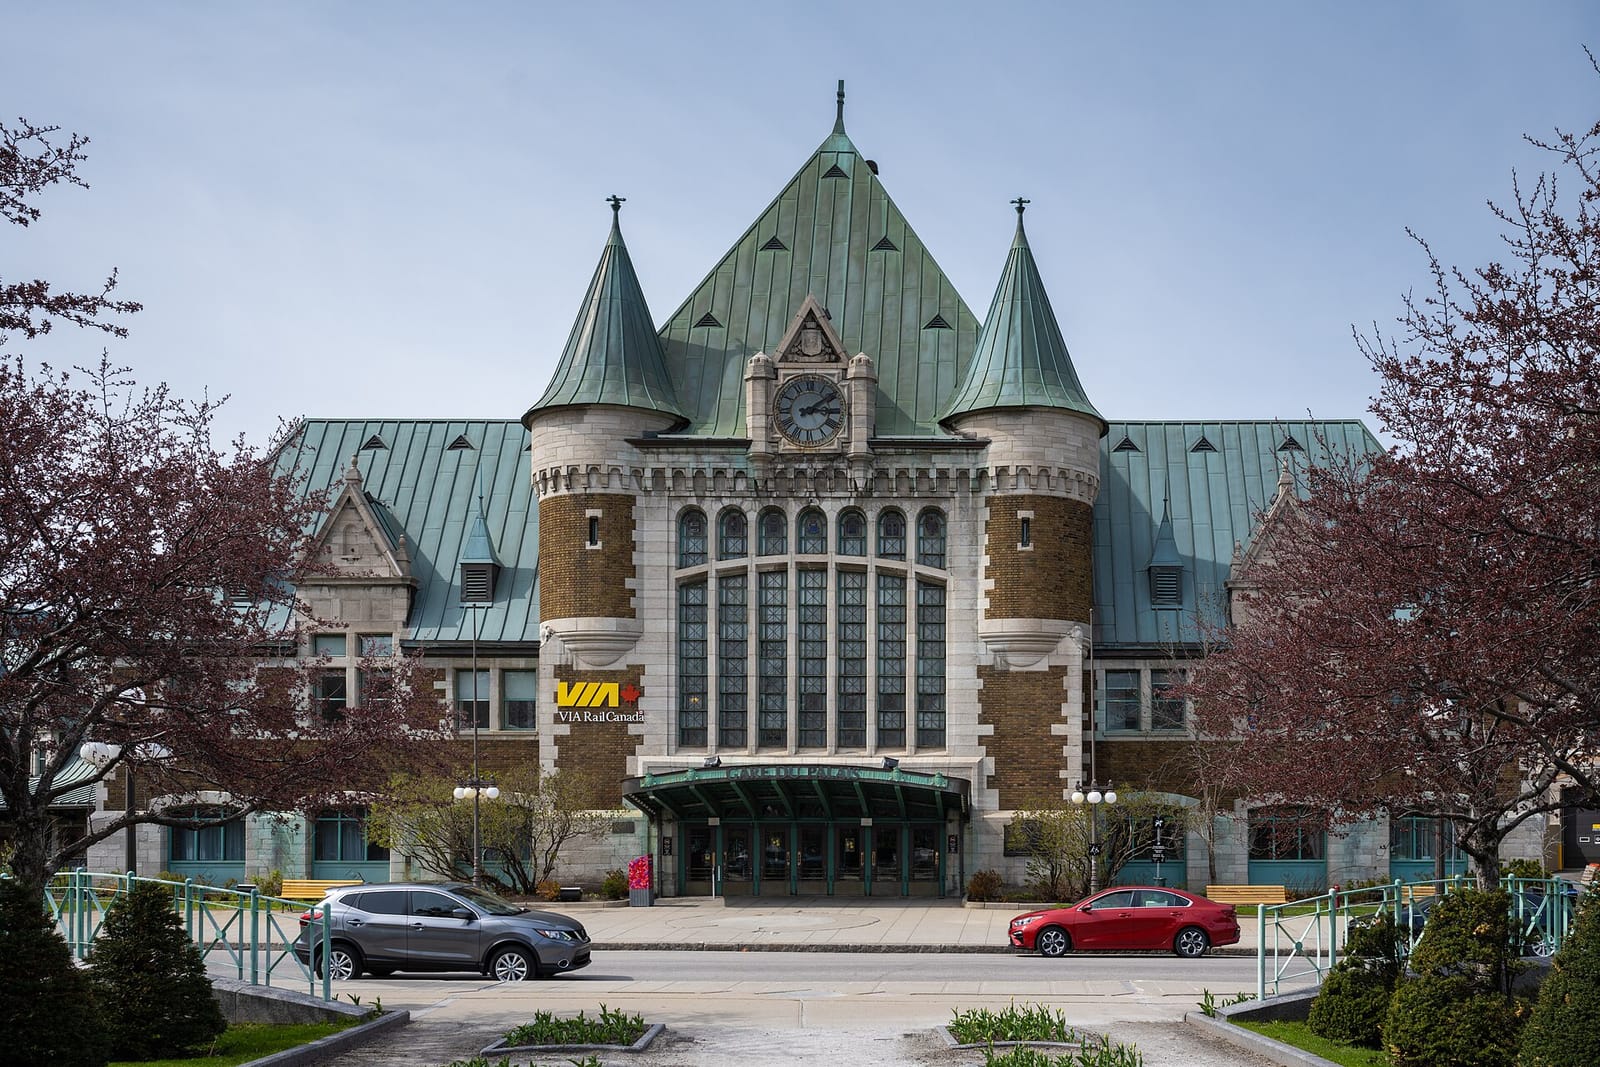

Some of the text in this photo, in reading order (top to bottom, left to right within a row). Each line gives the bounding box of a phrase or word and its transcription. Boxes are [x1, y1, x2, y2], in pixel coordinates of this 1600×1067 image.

[558, 682, 619, 707] VIA
[559, 712, 582, 721] VIA
[728, 766, 860, 780] GARE DU PALAIS
